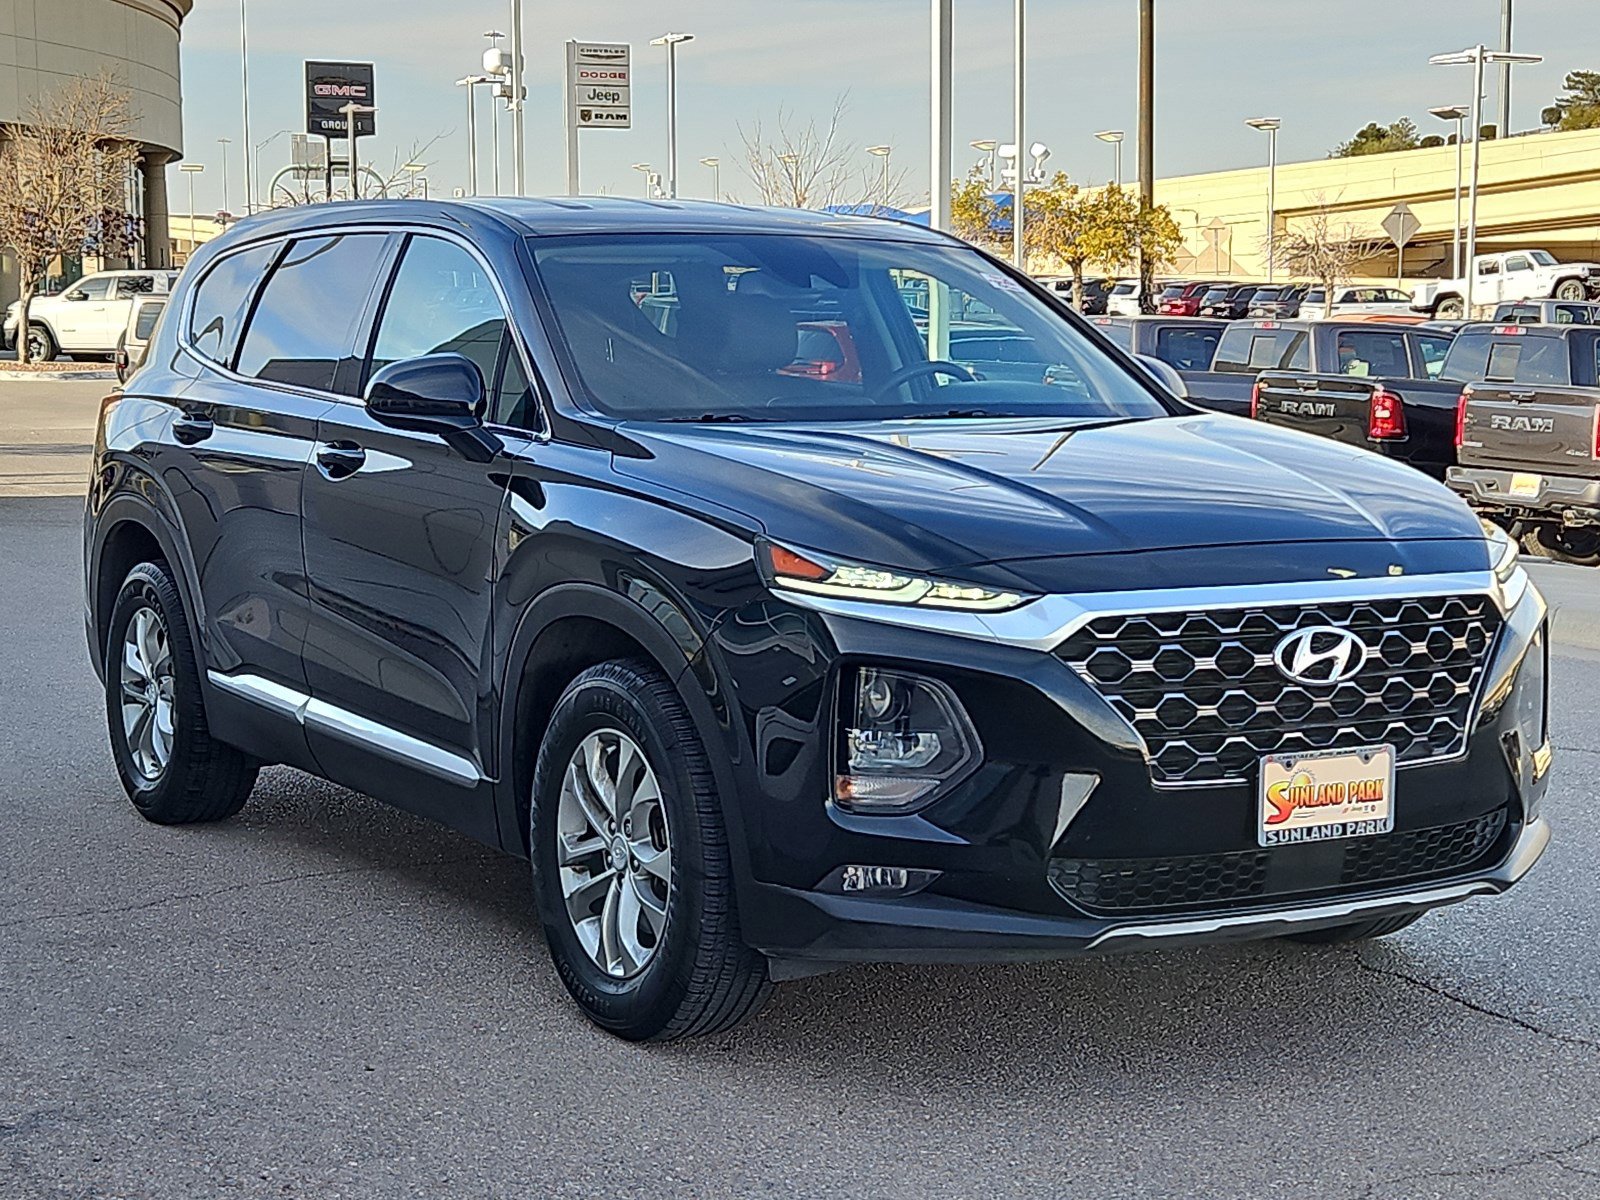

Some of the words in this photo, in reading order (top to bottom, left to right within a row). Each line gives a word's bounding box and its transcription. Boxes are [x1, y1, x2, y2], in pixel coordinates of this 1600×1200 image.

[580, 71, 627, 79] DODGE
[314, 84, 367, 97] GMC
[587, 88, 621, 104] Jeep
[321, 120, 350, 130] GROU
[594, 113, 628, 121] RAM
[1280, 400, 1336, 417] RAM
[1490, 414, 1554, 433] RAM
[1348, 778, 1385, 804] PARK
[1267, 824, 1343, 844] SUNLAND
[1346, 819, 1386, 837] PARK
